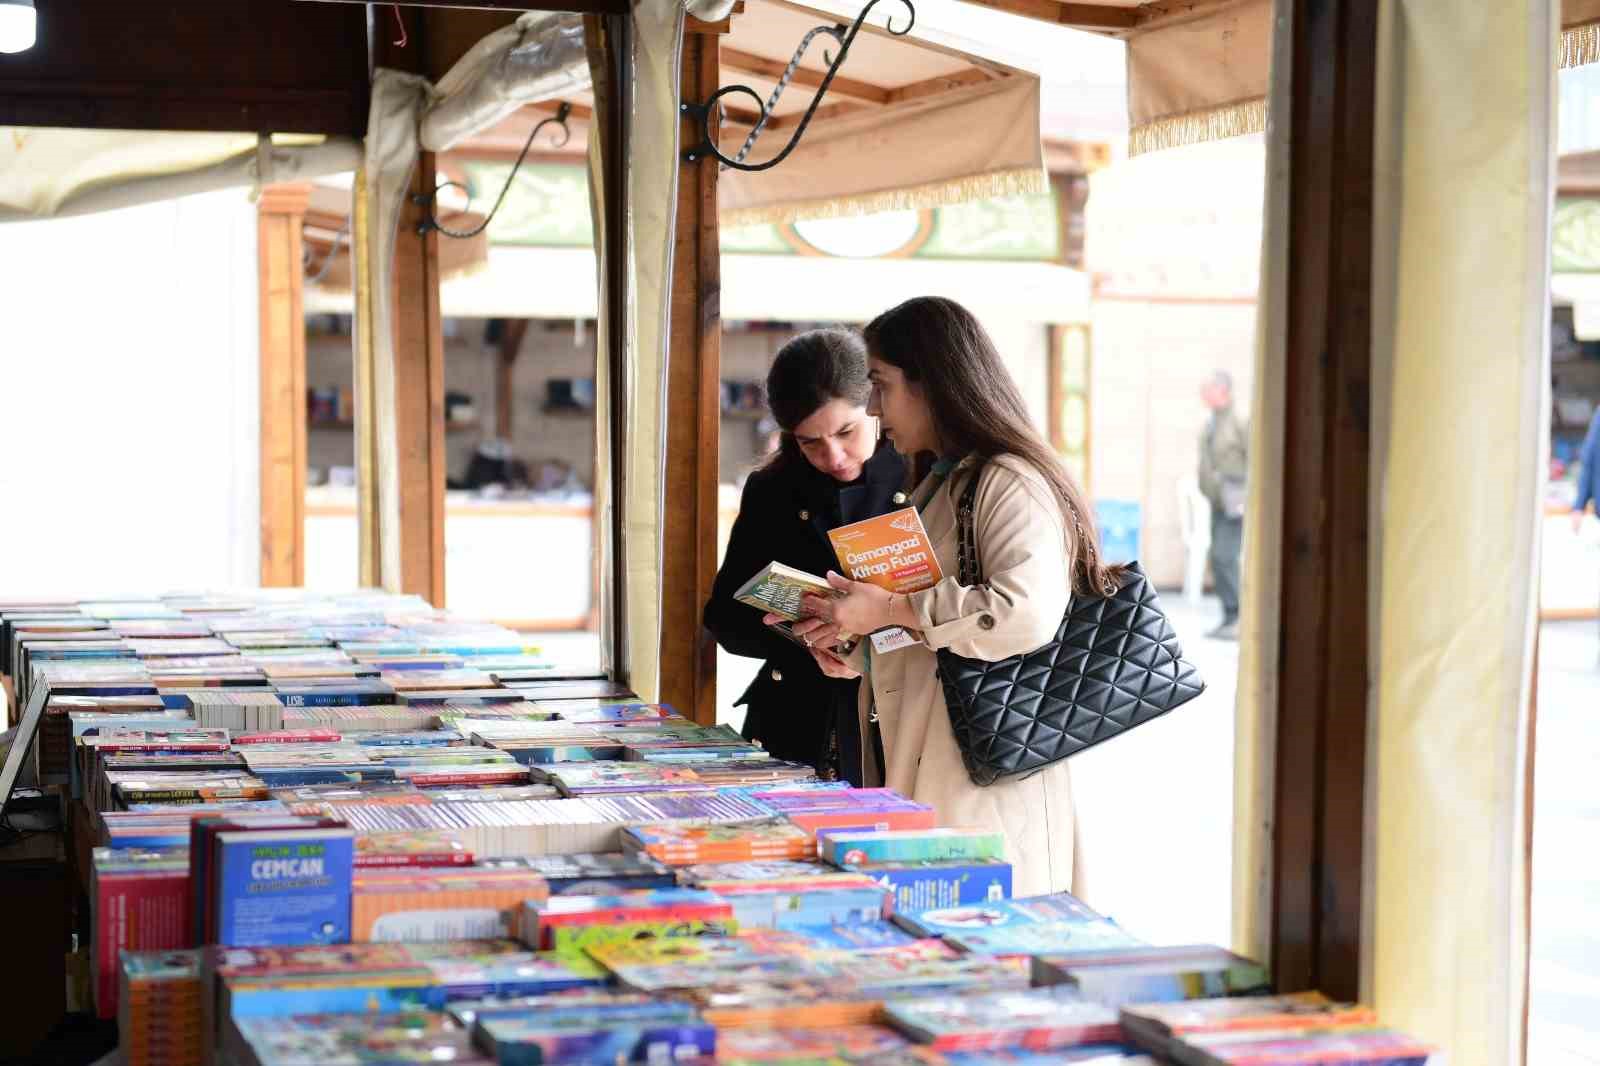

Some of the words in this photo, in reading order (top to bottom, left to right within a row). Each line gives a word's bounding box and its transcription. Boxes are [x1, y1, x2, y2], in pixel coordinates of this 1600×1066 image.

[847, 535, 920, 564] Osmangazi
[851, 562, 889, 579] Kitap
[251, 858, 324, 879] CEMCAN
